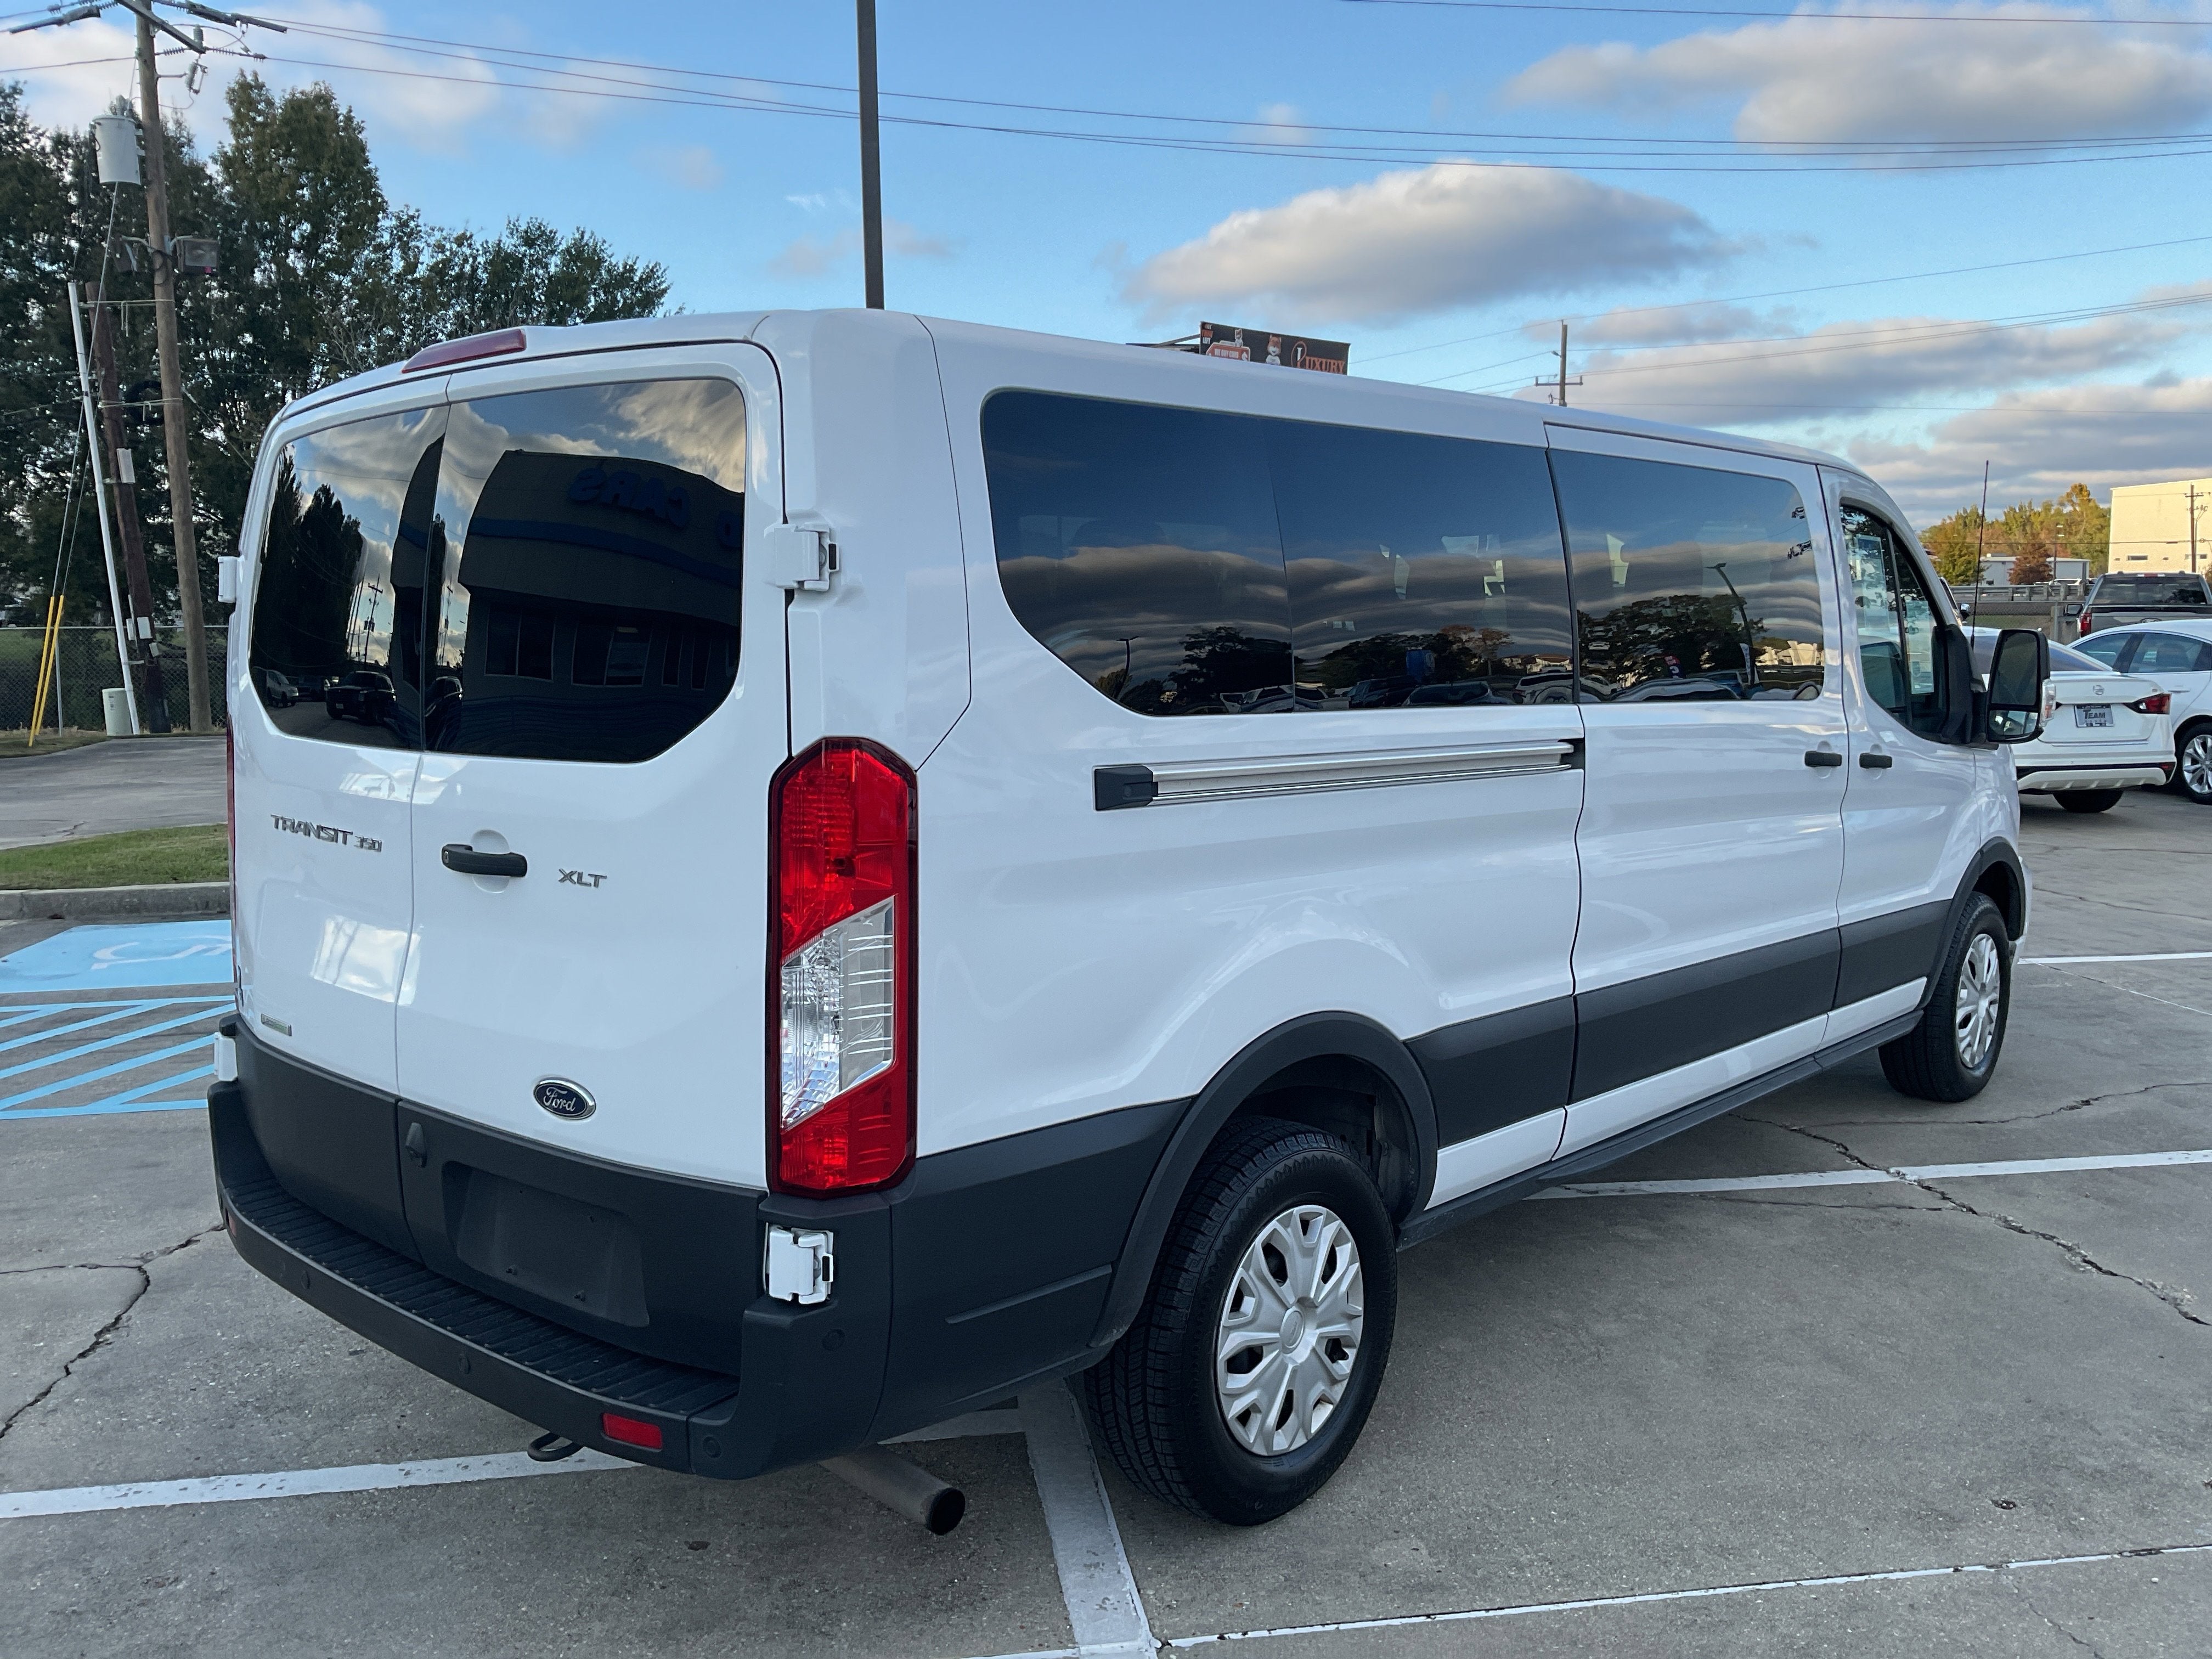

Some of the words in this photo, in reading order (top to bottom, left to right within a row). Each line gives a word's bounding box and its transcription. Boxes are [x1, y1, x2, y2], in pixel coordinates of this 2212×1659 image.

[2083, 709, 2106, 719] TEAM
[270, 814, 353, 845] TRANSIT
[353, 836, 382, 853] 350
[558, 868, 607, 888] XLT
[543, 1086, 576, 1111] Ford
